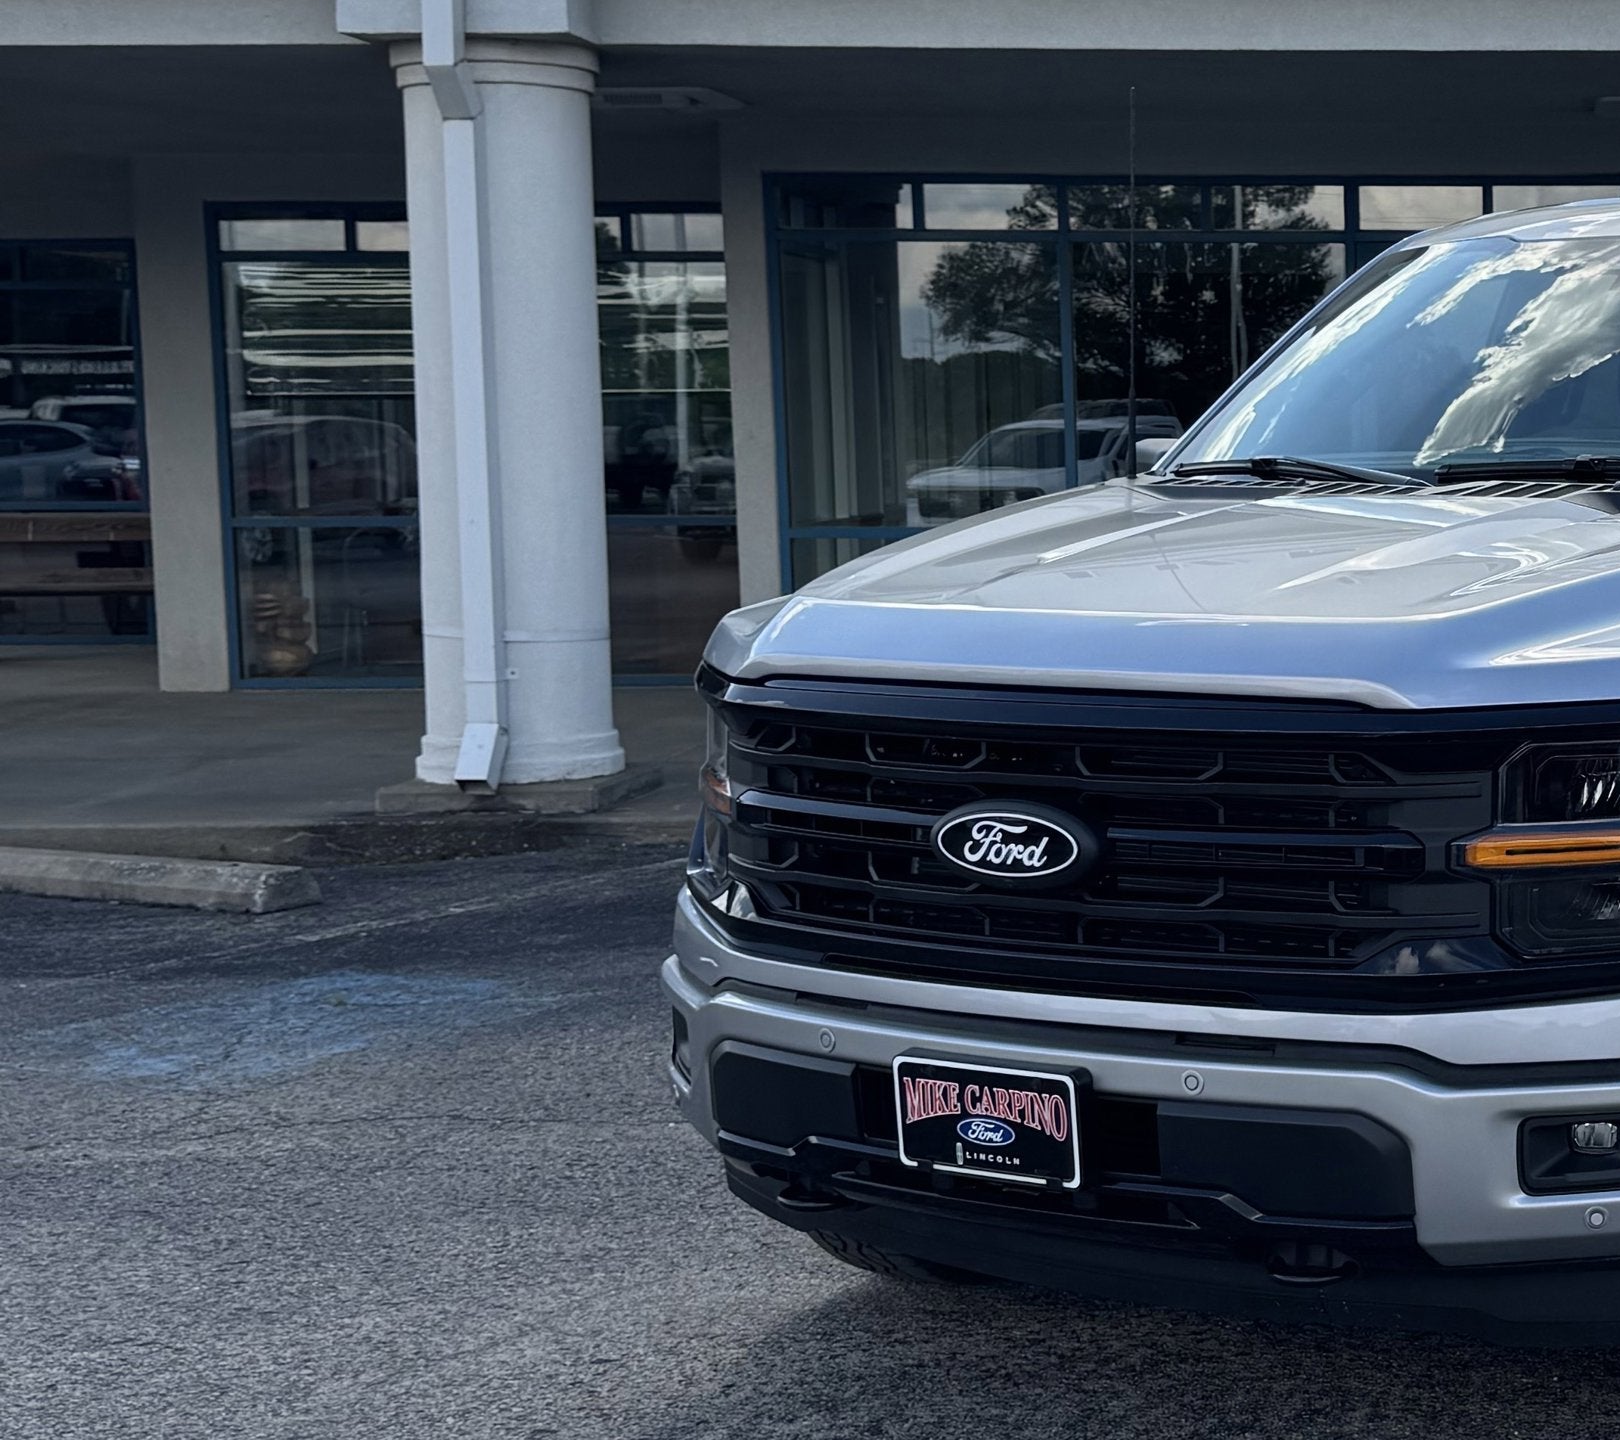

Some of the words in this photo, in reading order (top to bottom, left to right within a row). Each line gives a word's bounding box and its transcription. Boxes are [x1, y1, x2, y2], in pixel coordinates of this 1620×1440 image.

[963, 820, 1050, 868] Ford
[903, 1076, 961, 1125] MIKE
[963, 1083, 1068, 1142] CARPINO
[967, 1120, 1004, 1143] Ford
[965, 1150, 1021, 1166] LINCOLN
